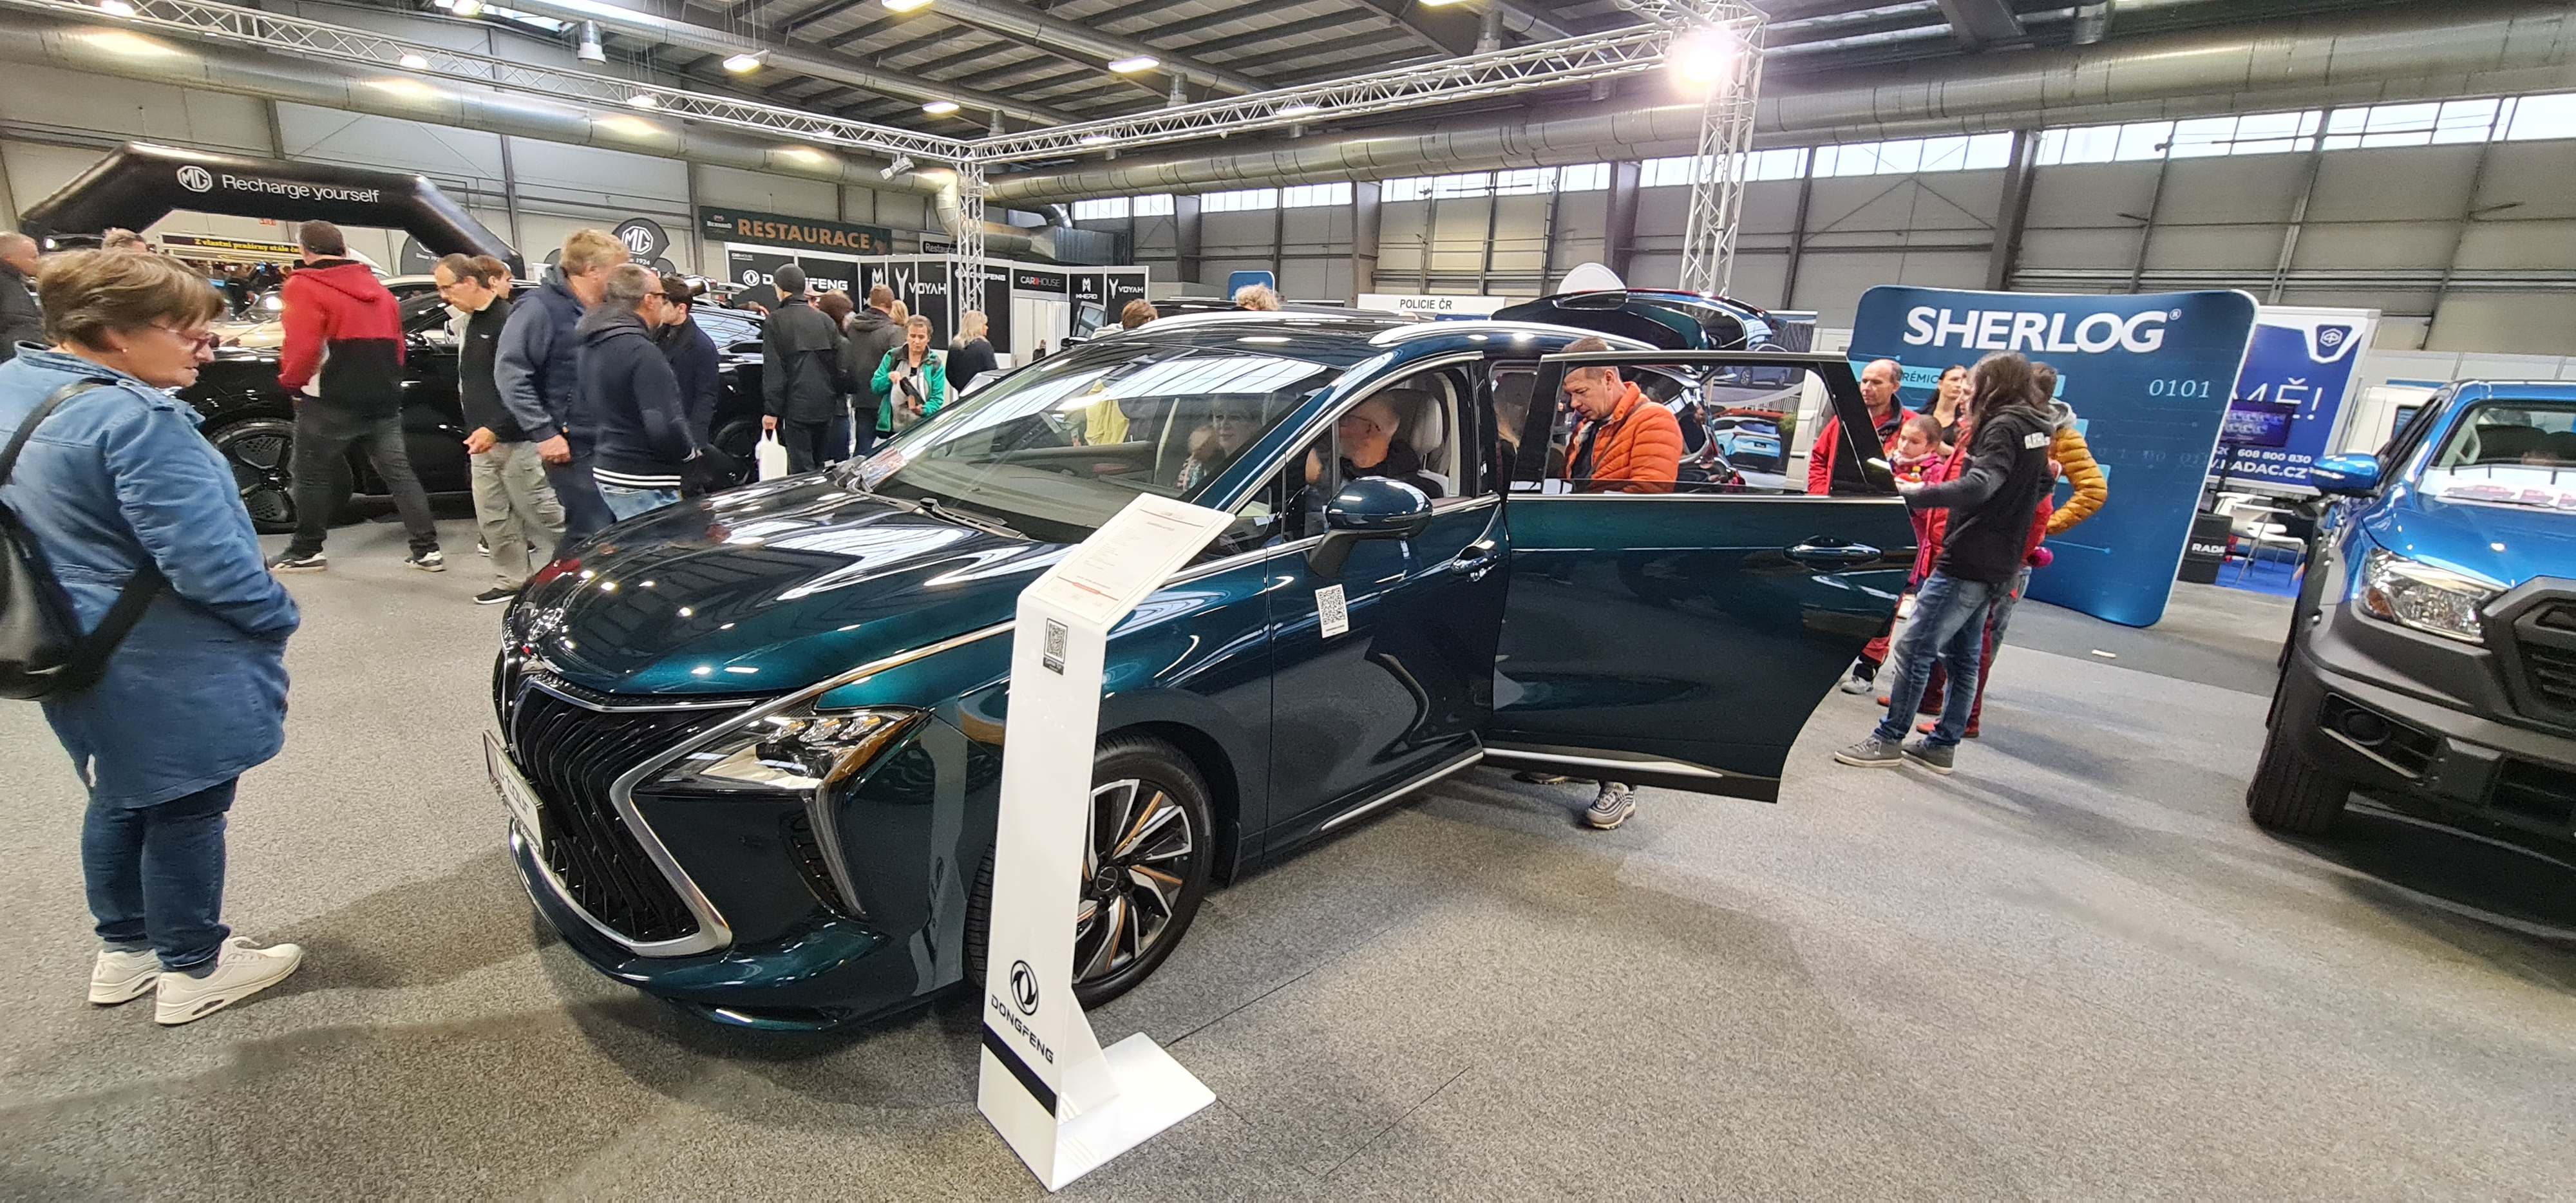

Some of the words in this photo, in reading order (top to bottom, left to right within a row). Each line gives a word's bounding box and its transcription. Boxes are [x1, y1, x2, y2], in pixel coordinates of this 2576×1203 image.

[178, 167, 211, 191] MG
[222, 174, 310, 199] Recharge
[314, 187, 380, 203] yourself
[623, 227, 652, 254] MG
[737, 218, 870, 249] RESTAURACE
[762, 274, 848, 290] DFENG
[909, 282, 947, 294] VOYAH
[1399, 299, 1435, 309] POLICIE
[1439, 298, 1452, 310] ČR
[2148, 379, 2210, 398] 0101
[2237, 448, 2260, 459] 608
[2262, 451, 2286, 461] 800
[2288, 454, 2312, 464] 830
[991, 994, 1054, 1065] DONGFENG
